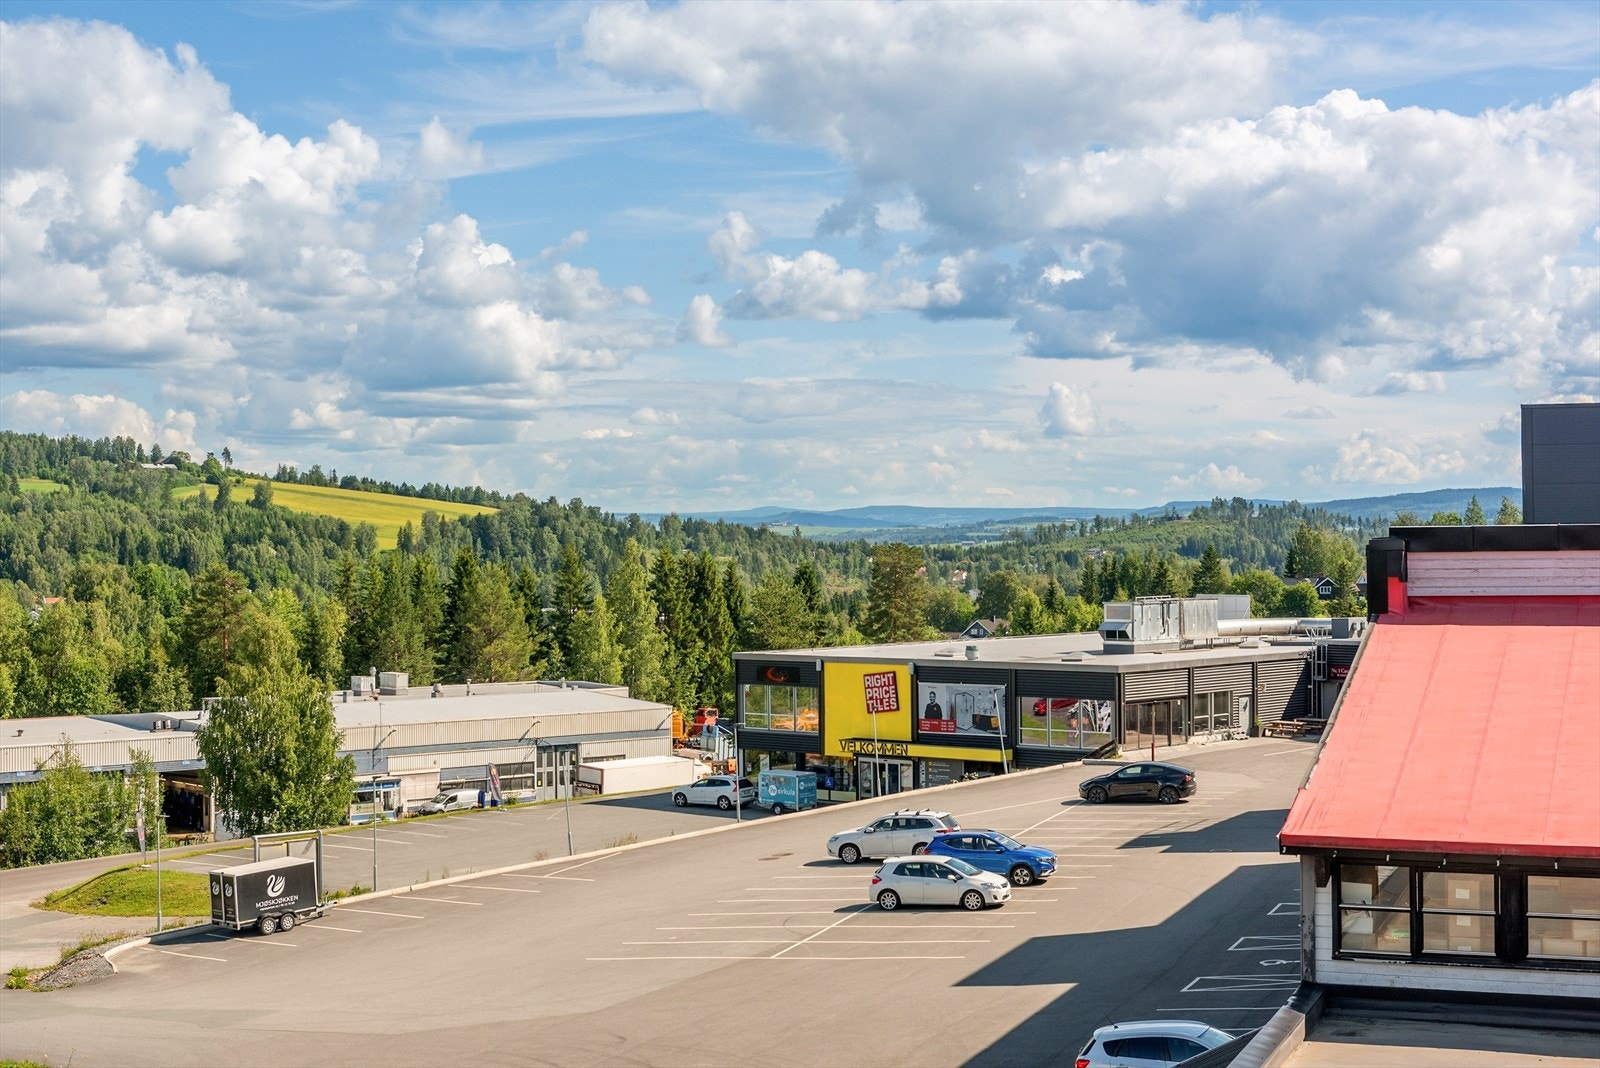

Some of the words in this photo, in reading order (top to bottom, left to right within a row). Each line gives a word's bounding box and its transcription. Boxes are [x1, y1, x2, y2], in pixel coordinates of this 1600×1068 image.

[864, 673, 894, 688] RIGHT
[866, 685, 896, 700] PRICE
[867, 698, 898, 712] TILES
[839, 740, 909, 756] VELKOMMEN
[255, 894, 299, 909] MJØSKJØKKEN
